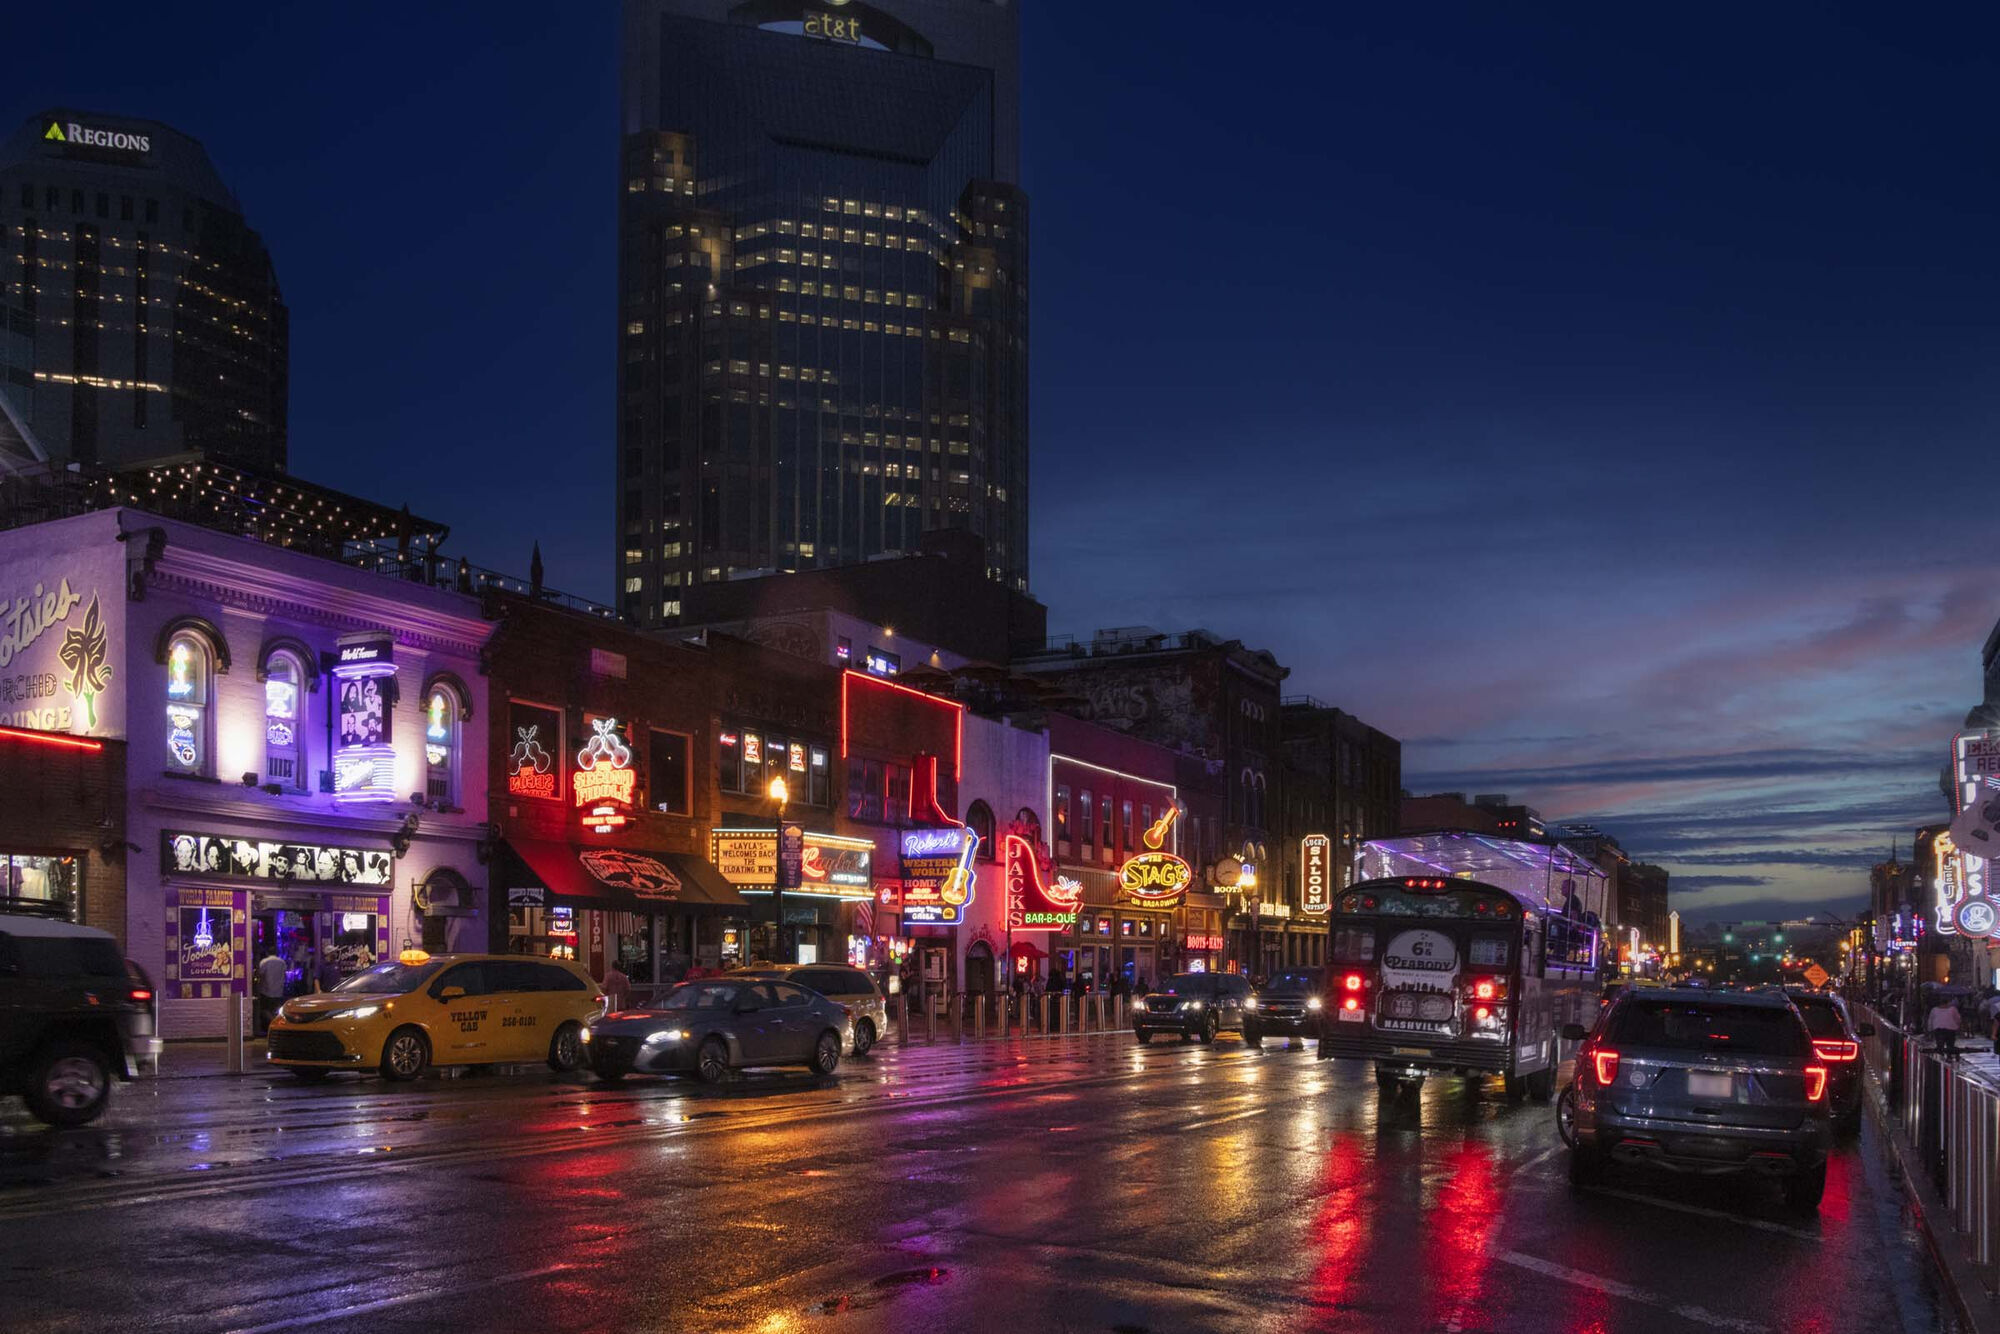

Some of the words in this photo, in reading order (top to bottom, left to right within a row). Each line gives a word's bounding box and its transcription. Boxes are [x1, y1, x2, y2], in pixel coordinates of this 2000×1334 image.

[805, 14, 859, 40] at&t
[67, 123, 150, 152] REGIONS
[0, 706, 74, 730] OUNGE
[1305, 838, 1326, 847] LUCKY
[722, 850, 757, 858] WELCOMES
[744, 858, 756, 866] THE
[903, 859, 957, 868] WESTERN
[723, 865, 756, 874] FLOATING
[911, 868, 950, 877] WORLD
[1124, 860, 1188, 890] STAGE
[1308, 846, 1322, 904] SALOON
[904, 879, 937, 888] HOME
[1008, 843, 1026, 927] JACKS
[1025, 913, 1077, 924] BAR-B-QUE
[1187, 936, 1206, 950] BOOTS
[1385, 955, 1450, 970] PEABODY
[451, 1010, 488, 1022] YELLOW
[460, 1022, 479, 1033] CAB
